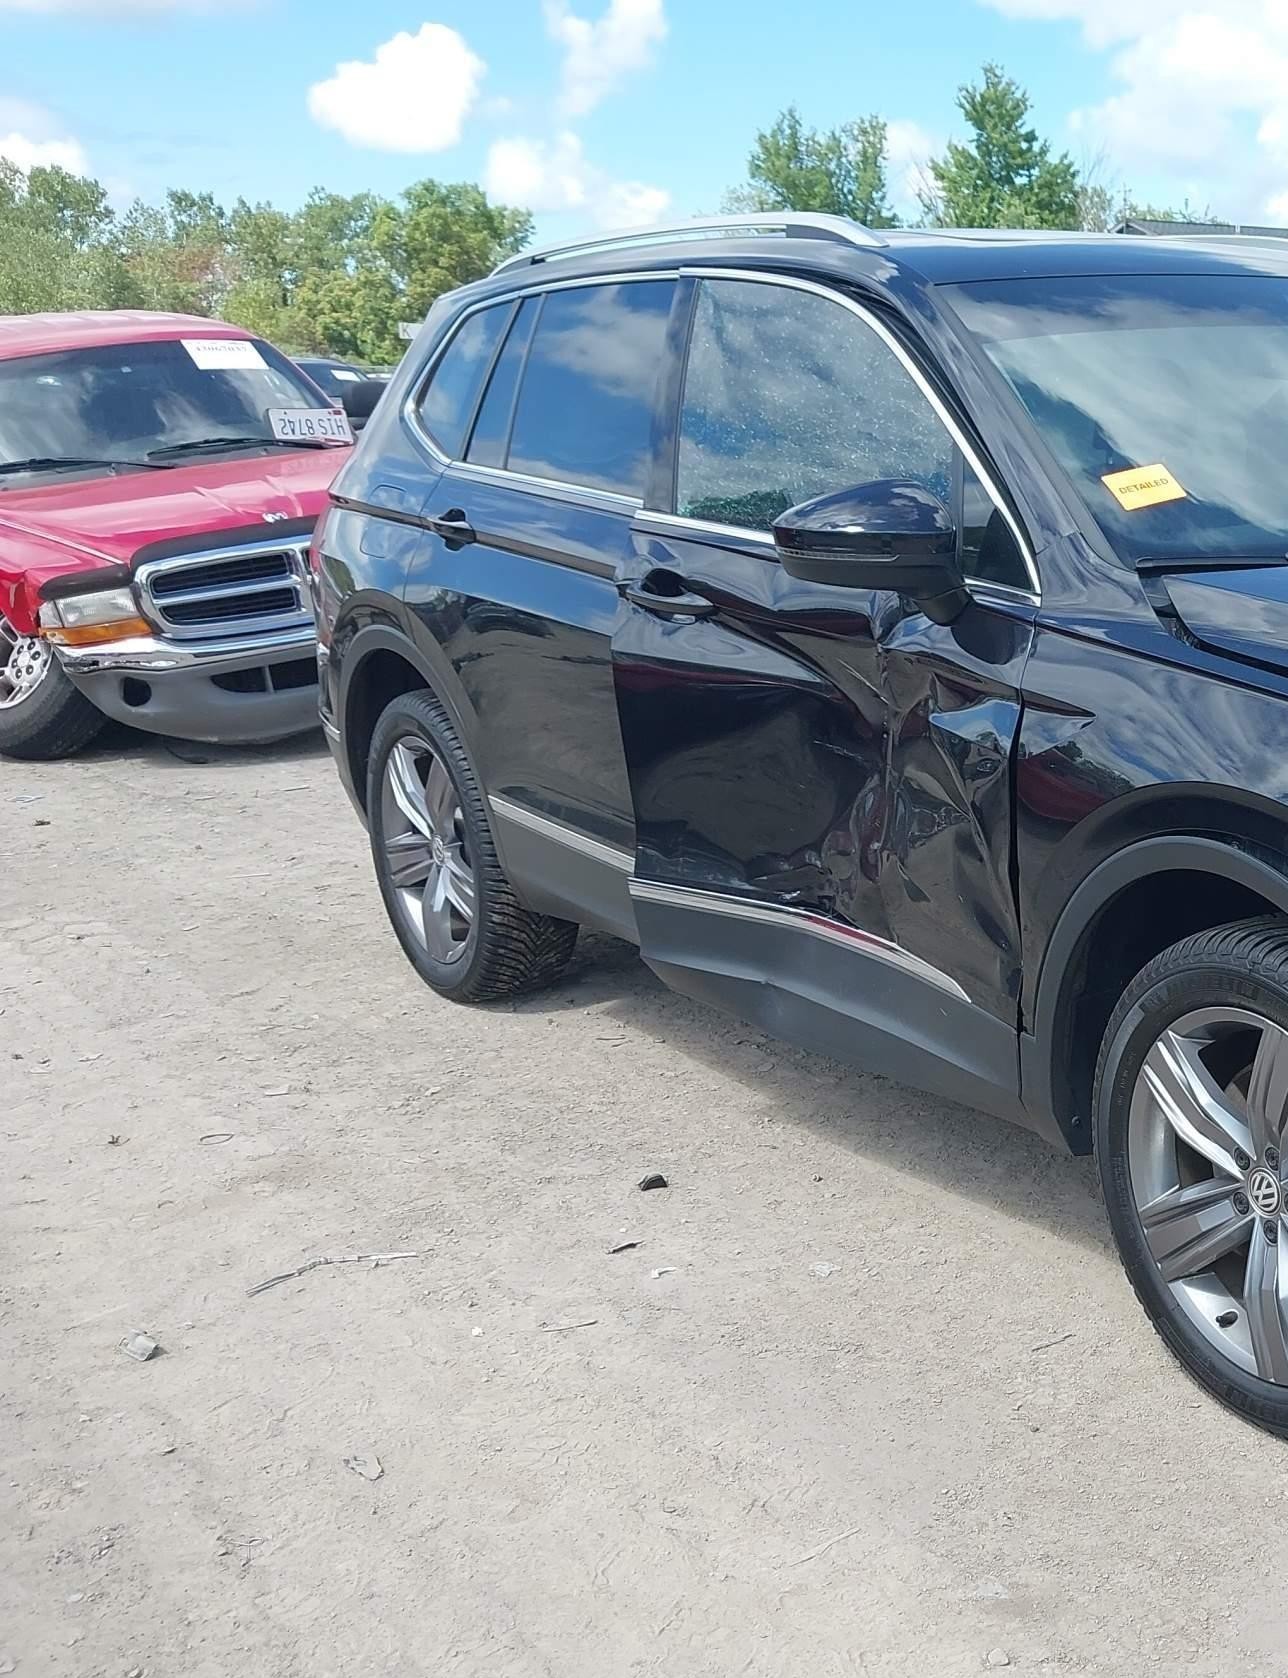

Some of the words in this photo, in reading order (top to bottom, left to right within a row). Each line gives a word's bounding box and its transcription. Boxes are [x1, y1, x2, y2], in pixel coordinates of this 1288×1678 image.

[279, 418, 315, 435] 8742
[318, 418, 346, 435] HIS
[1118, 478, 1168, 494] DETAILED
[1250, 1170, 1279, 1214] VW
